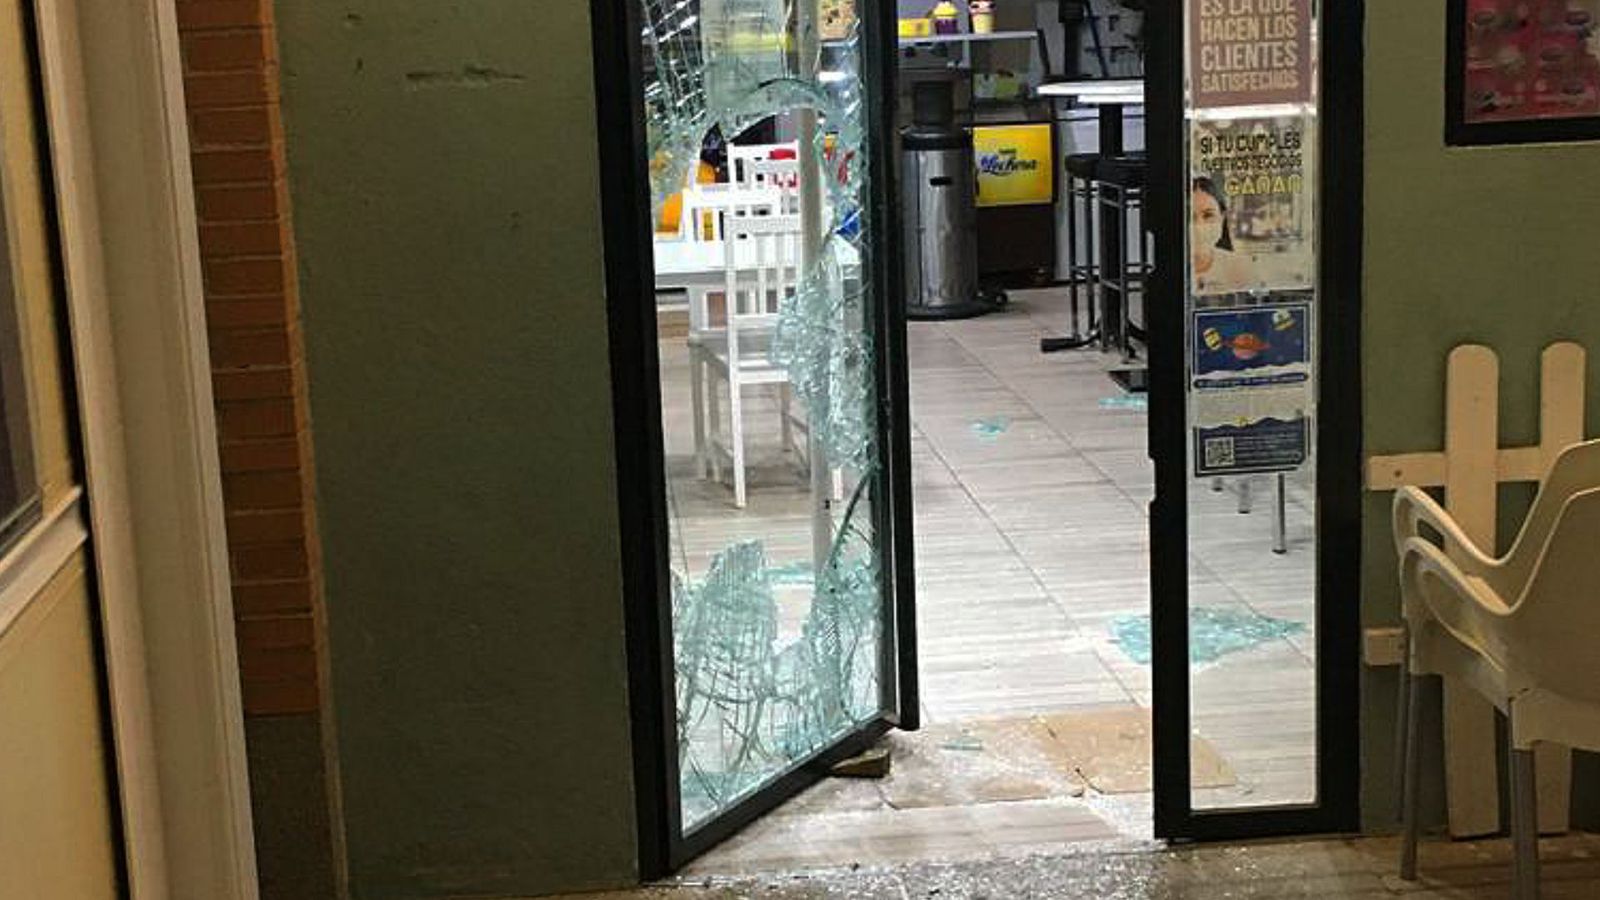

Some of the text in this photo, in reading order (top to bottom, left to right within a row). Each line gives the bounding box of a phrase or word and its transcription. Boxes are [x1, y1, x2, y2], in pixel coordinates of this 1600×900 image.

[1201, 0, 1223, 16] ES
[1229, 0, 1252, 15] LA
[1201, 14, 1297, 43] HACEN LOS
[1201, 40, 1298, 71] CLIENTES
[1201, 69, 1299, 93] SATISFECHOS
[1201, 130, 1301, 154] SI TU CUMPLES
